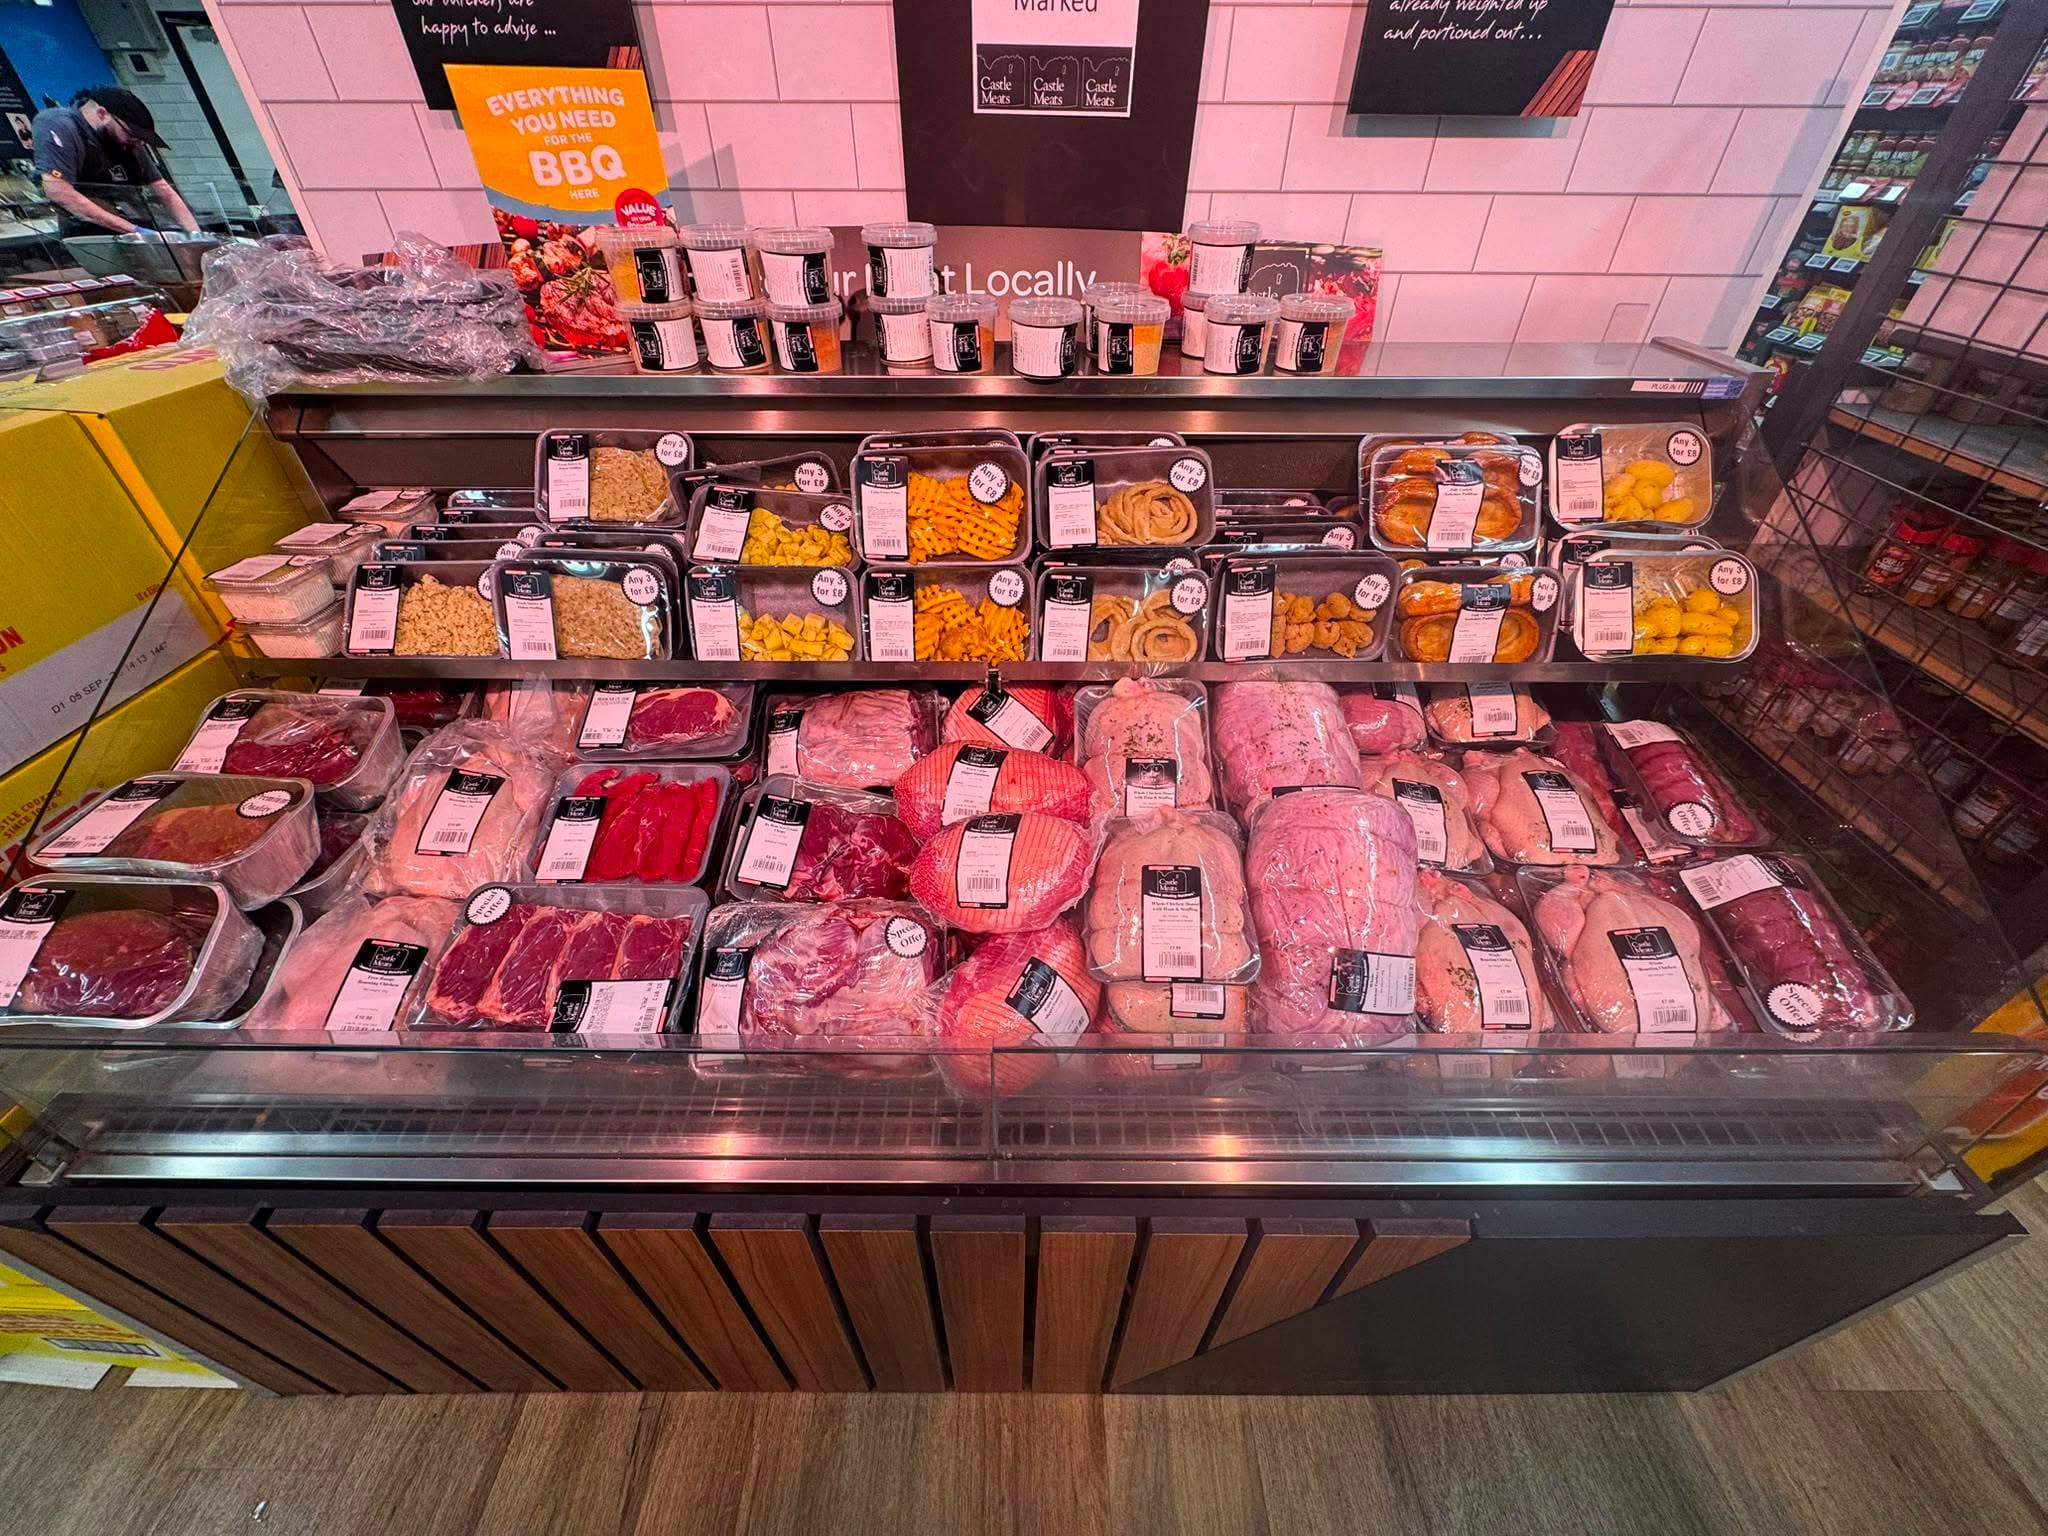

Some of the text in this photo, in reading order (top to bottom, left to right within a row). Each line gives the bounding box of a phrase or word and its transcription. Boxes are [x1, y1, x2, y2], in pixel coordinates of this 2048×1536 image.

[421, 16, 468, 46] happy
[472, 17, 488, 35] to
[493, 16, 538, 41] advise
[1383, 19, 1420, 40] and
[1413, 19, 1496, 50] portioned
[981, 76, 1012, 91] Castle
[1033, 77, 1065, 92] Castle
[1085, 78, 1118, 93] Castle
[485, 86, 625, 117] EVERYTHING
[982, 91, 1011, 104] Meats
[1033, 92, 1063, 106] Meats
[1085, 93, 1115, 107] Meats
[510, 109, 616, 136] YOU NEED
[543, 132, 593, 146] FOR THE
[528, 144, 627, 187] BBQ
[569, 189, 599, 200] HERE
[621, 204, 657, 215] VALUE
[966, 260, 1097, 297] Locally
[662, 438, 683, 449] Any 3
[1674, 437, 1698, 448] Any 3
[661, 448, 683, 457] for £8
[1673, 448, 1697, 457] for £8
[798, 467, 823, 478] Any 3
[1178, 461, 1203, 476] Any 3
[798, 478, 824, 487] for £8
[980, 466, 1003, 487] Any 3
[1172, 472, 1199, 487] for £8
[973, 476, 997, 498] for £8
[823, 511, 834, 521] for
[829, 505, 844, 517] Any
[520, 530, 535, 541] Any
[1328, 531, 1344, 541] Any
[500, 548, 516, 558] Any
[1717, 565, 1732, 575] Any
[629, 575, 652, 585] Any 3
[817, 576, 843, 586] Any 3
[996, 575, 1021, 588] Any 3
[1364, 577, 1388, 590] Any 3
[1717, 576, 1742, 585] for £8
[630, 586, 655, 595] for £8
[817, 587, 843, 597] for £8
[994, 587, 1018, 598] for £8
[1179, 583, 1204, 595] Any 3
[1176, 594, 1201, 606] for £8
[1357, 588, 1382, 604] for £8
[51, 702, 66, 714] D1
[69, 692, 82, 703] 05
[82, 679, 103, 695] SEP
[1677, 810, 1692, 831] Offer
[1686, 802, 1706, 832] Special
[1158, 877, 1178, 886] Castle
[469, 890, 498, 919] Special
[483, 897, 505, 918] Offer
[889, 922, 920, 940] Special
[900, 933, 923, 948] Offer
[376, 954, 396, 962] Castle
[1787, 986, 1821, 1019] Special
[1779, 997, 1804, 1022] Offer
